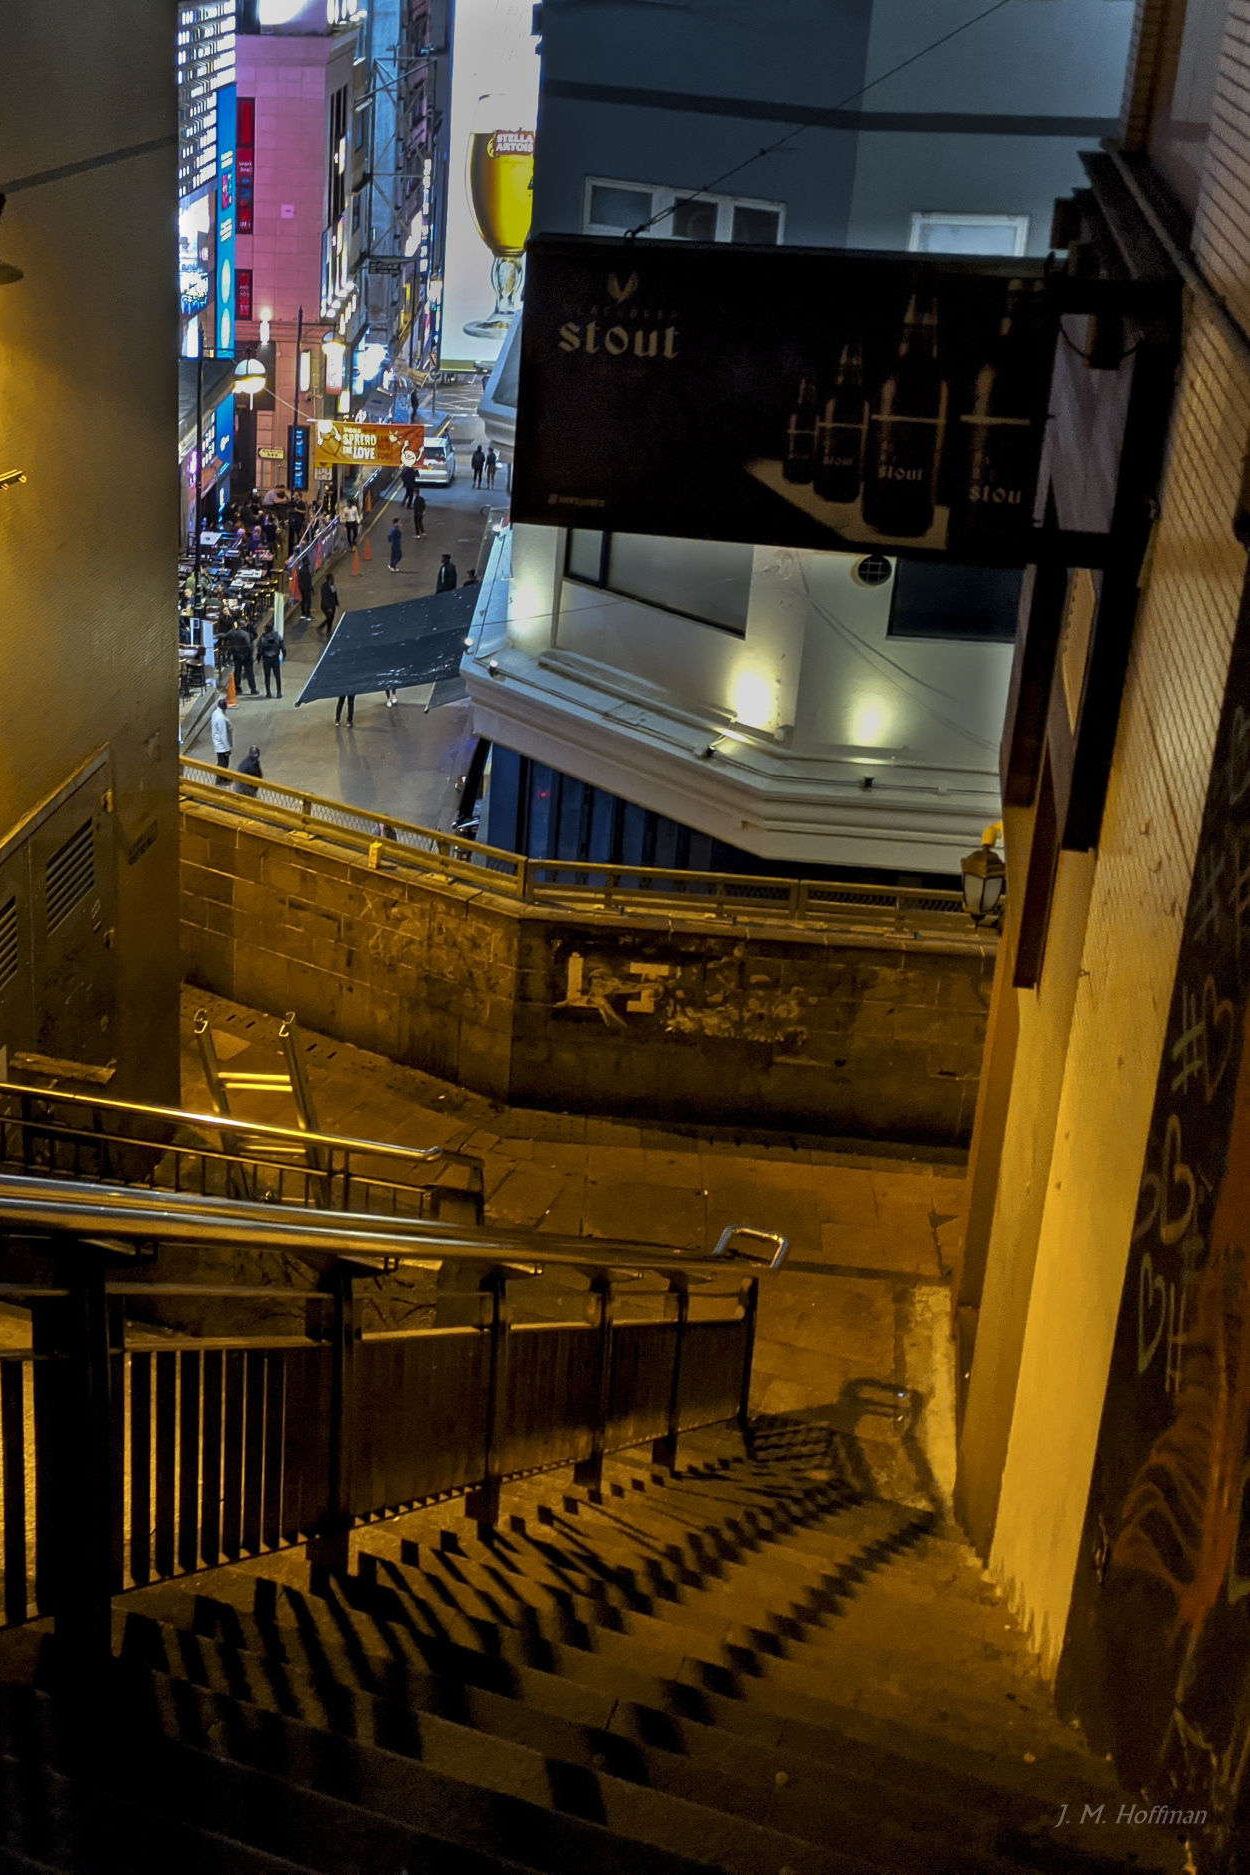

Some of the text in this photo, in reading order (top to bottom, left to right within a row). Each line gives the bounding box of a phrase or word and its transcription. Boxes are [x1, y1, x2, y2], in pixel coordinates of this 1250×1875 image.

[496, 133, 533, 143] STELLA
[558, 321, 679, 360] stout
[343, 433, 377, 446] SPREAD
[353, 446, 376, 460] LOVE
